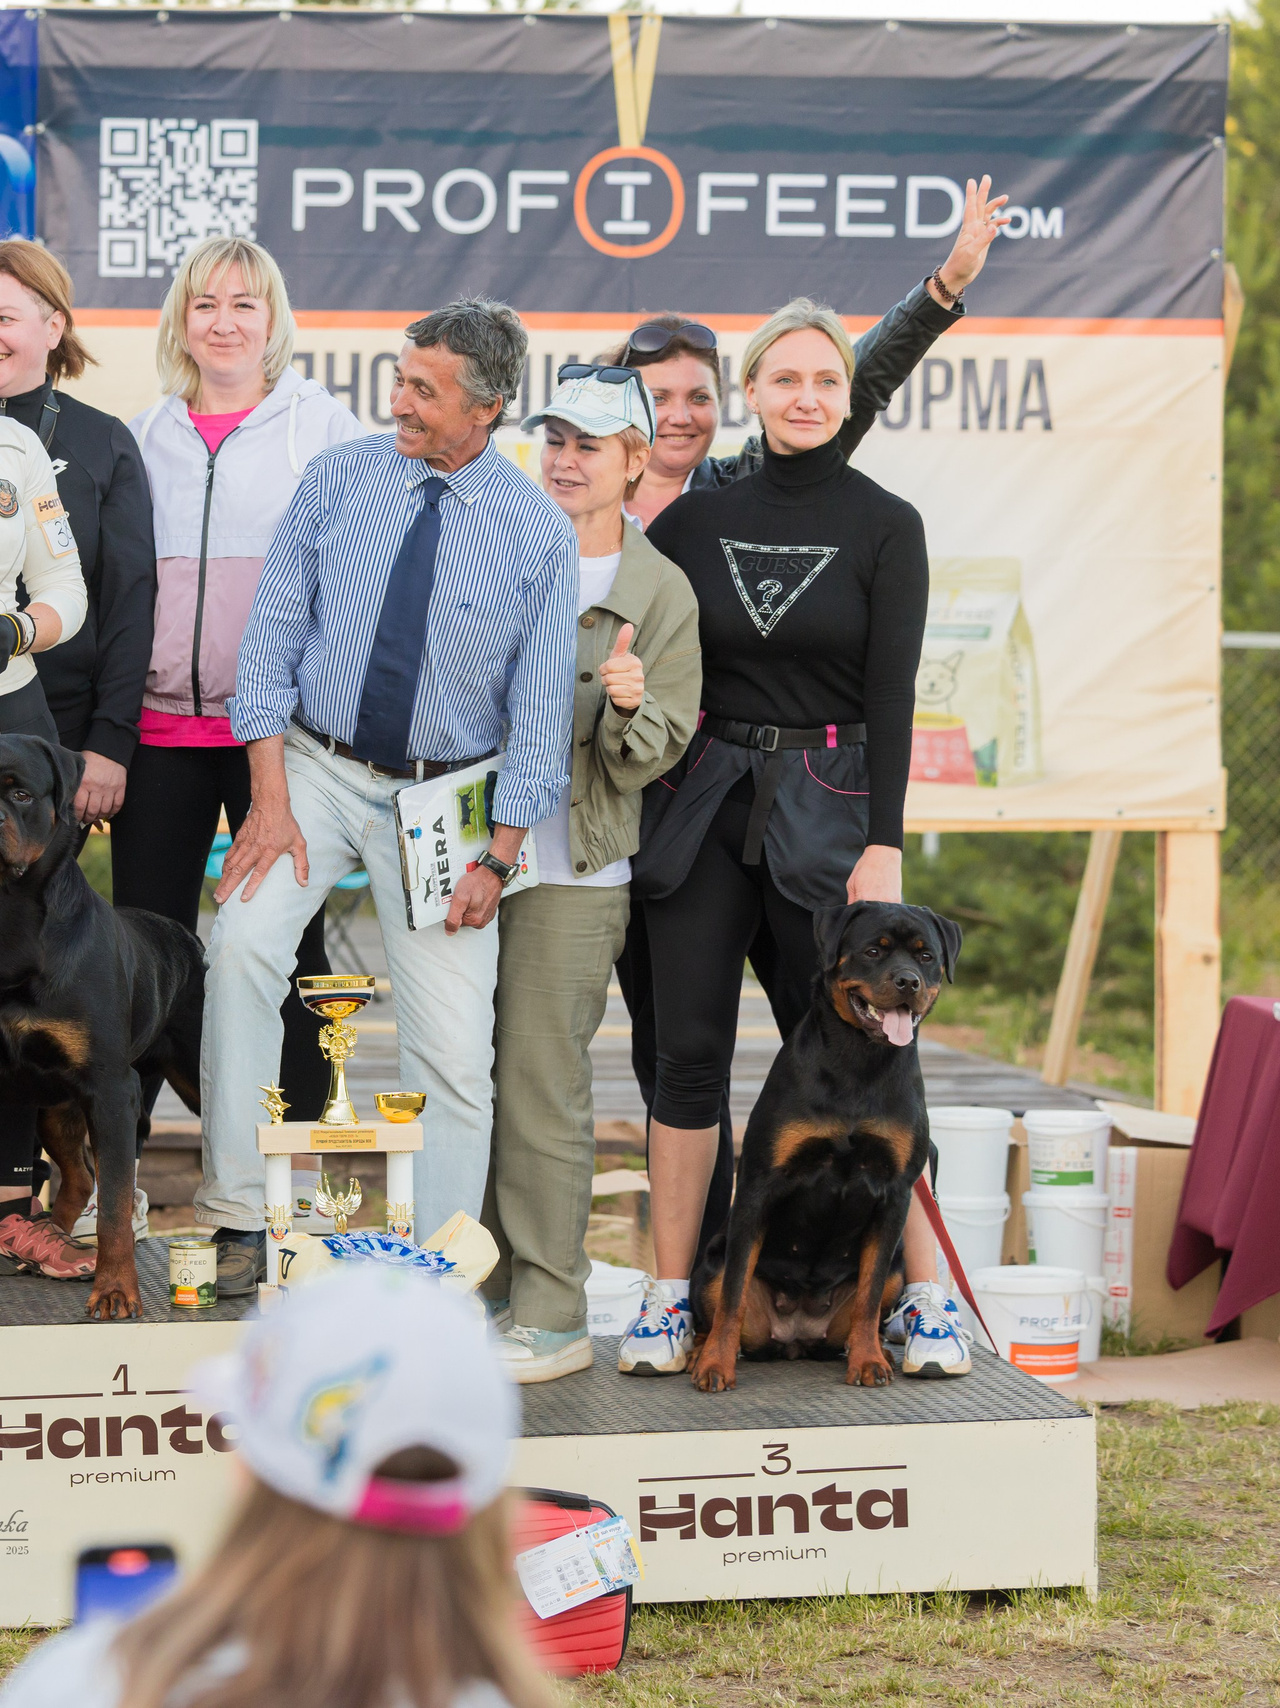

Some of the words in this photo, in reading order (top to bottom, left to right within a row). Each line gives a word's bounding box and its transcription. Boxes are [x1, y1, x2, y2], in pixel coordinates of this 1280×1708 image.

[739, 555, 813, 574] GUESS
[432, 815, 452, 897] NERA
[111, 1364, 137, 1396] 1
[761, 1443, 792, 1476] 3
[69, 1467, 176, 1487] premium
[638, 1482, 909, 1543] Hanta
[722, 1545, 827, 1567] premium
